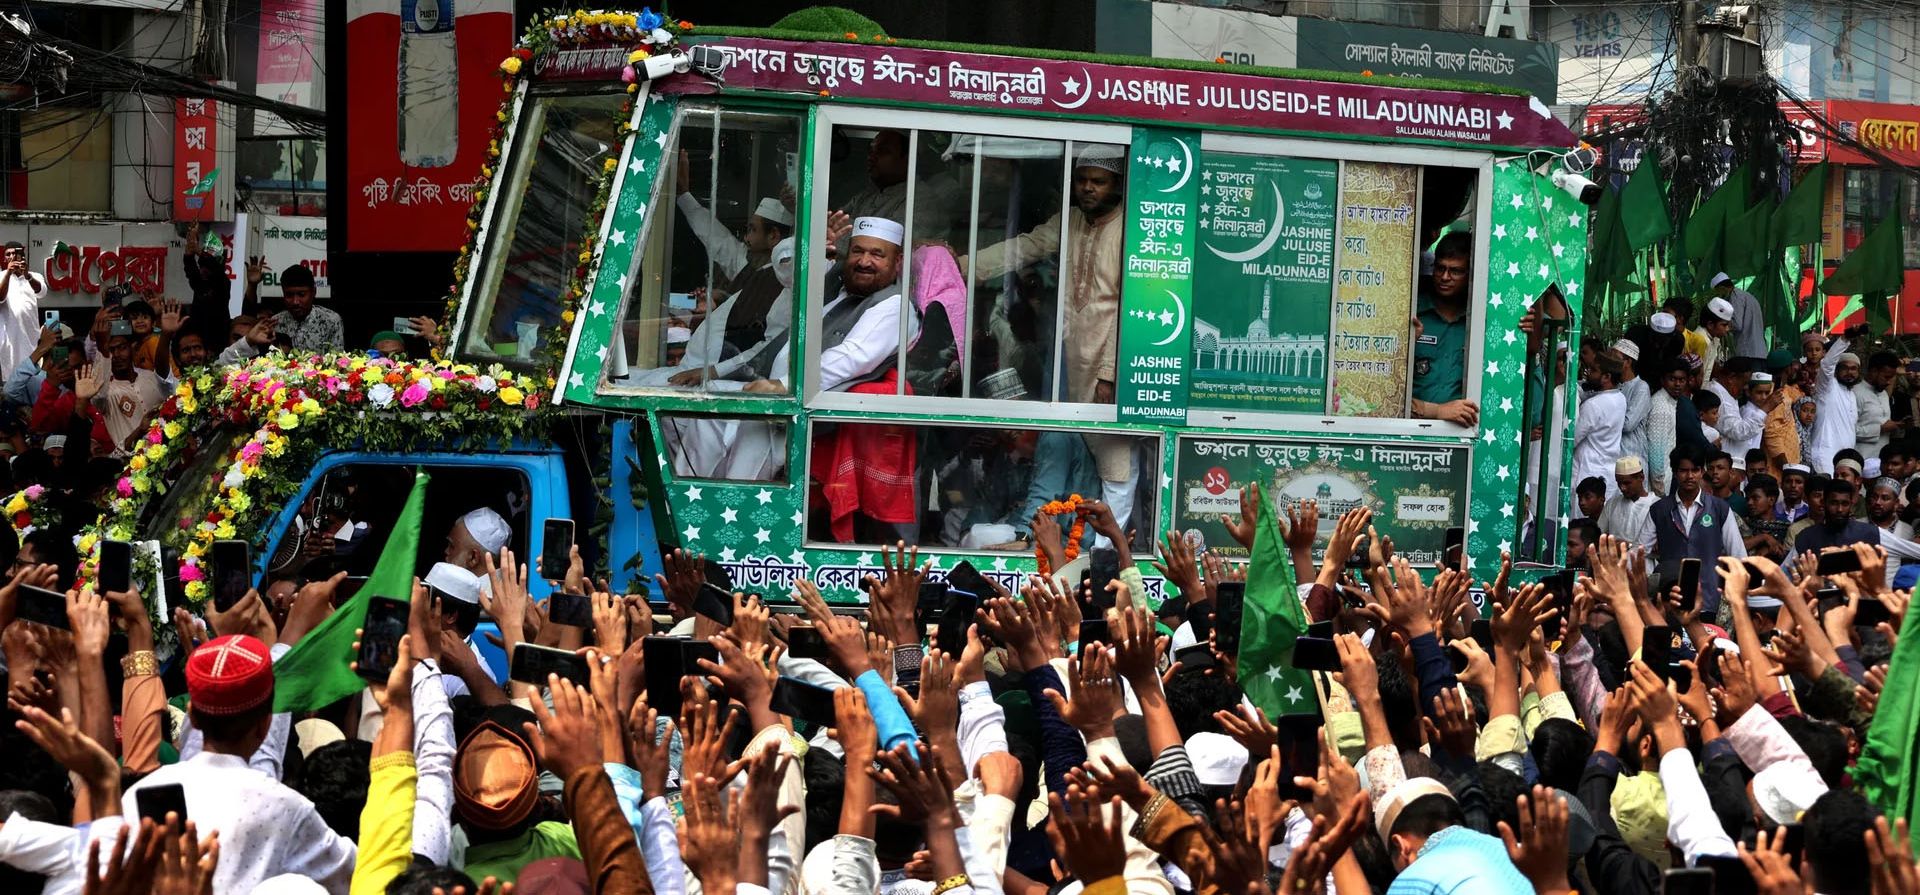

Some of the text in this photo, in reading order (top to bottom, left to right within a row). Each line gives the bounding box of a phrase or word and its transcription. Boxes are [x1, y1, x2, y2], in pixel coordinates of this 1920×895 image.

[1575, 43, 1621, 57] YEARS
[1345, 42, 1515, 75] সোশ্যাল ইসলামী ব্যাংক লিমিটেড
[1098, 79, 1491, 130] JASHNE JULUSEID-E MILADUNNABI
[1395, 126, 1491, 141] SALLALLAHU ALAIHI WASALLAM
[363, 177, 389, 209] পুষ্টি
[1139, 217, 1185, 238] জুলুছে
[1281, 226, 1332, 240] JASHNE
[1282, 239, 1331, 253] JULUSE
[1297, 253, 1330, 266] EID-E
[1242, 263, 1330, 279] MILADUNNABI
[1130, 356, 1182, 369] JASHNE
[1130, 372, 1180, 385] JULUSE
[1137, 389, 1171, 402] EID-E
[1122, 406, 1185, 416] MILADUNNABI
[1255, 444, 1311, 469] জুলুছে
[1370, 445, 1453, 472] মিলাদুন্নবী
[1207, 472, 1227, 490] ১২
[1402, 503, 1445, 513] সফল হোক
